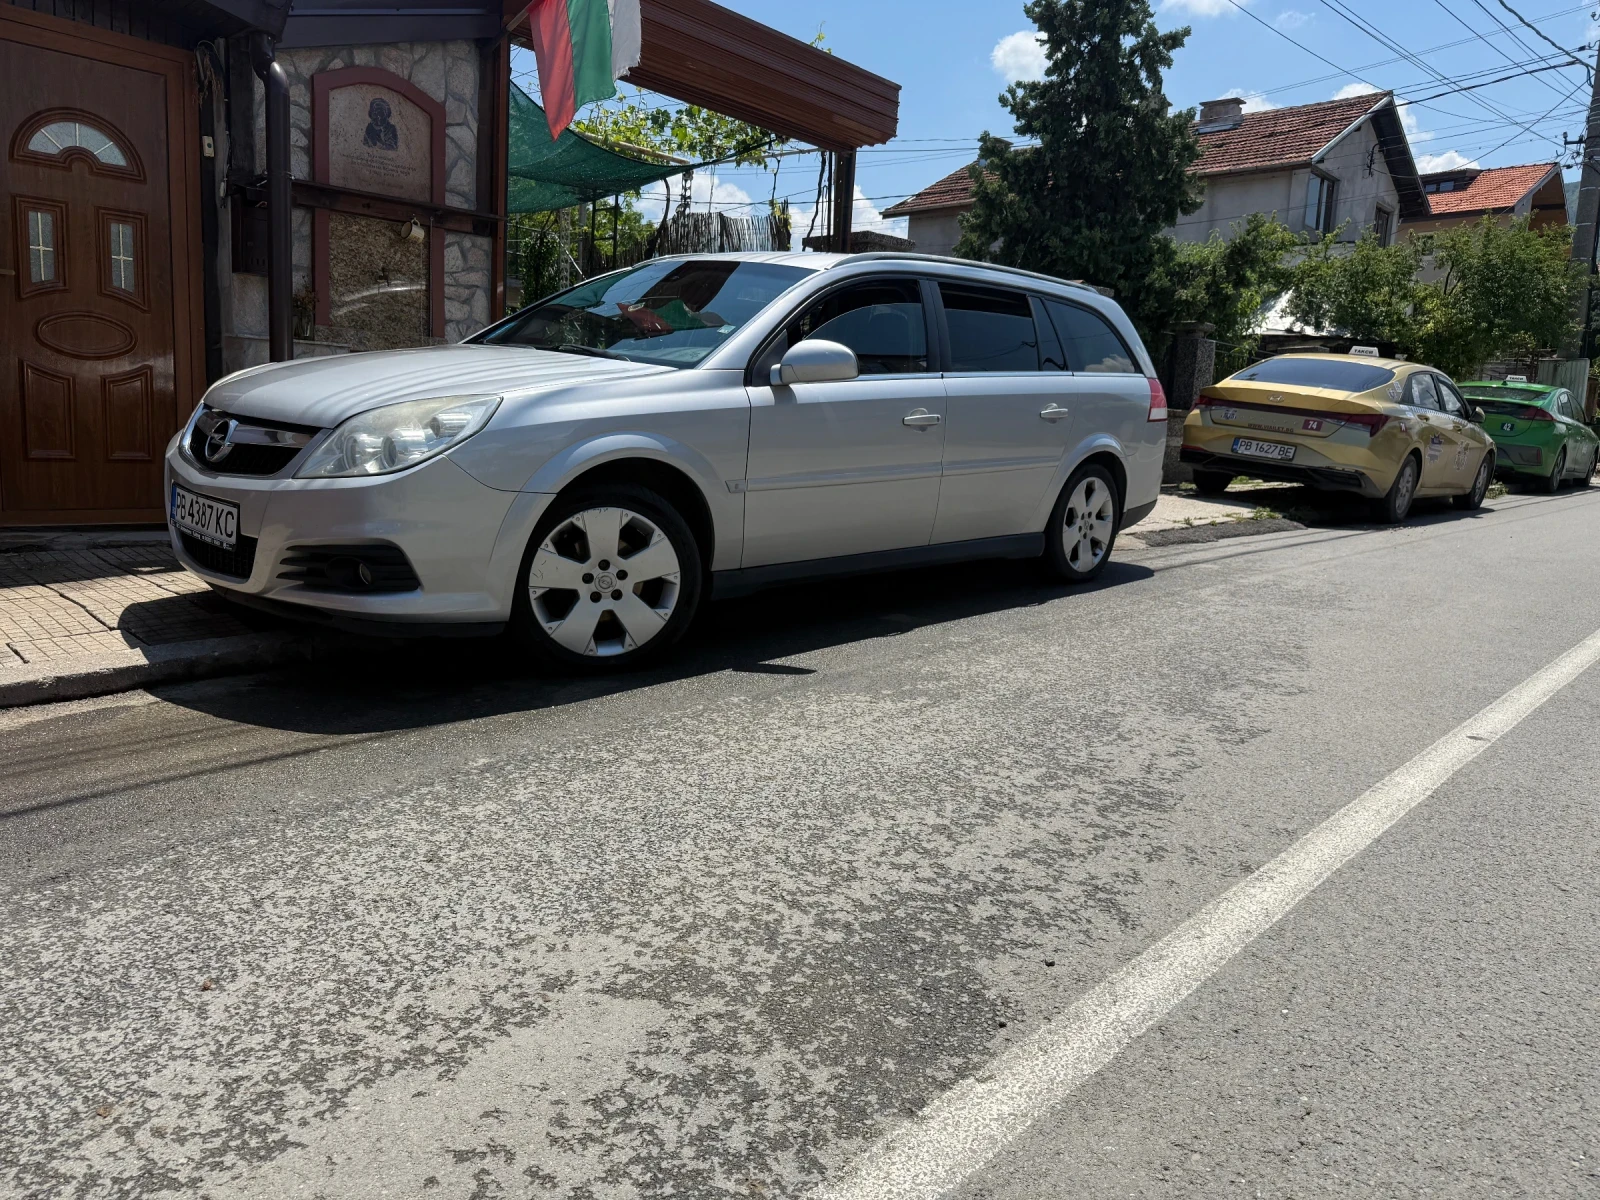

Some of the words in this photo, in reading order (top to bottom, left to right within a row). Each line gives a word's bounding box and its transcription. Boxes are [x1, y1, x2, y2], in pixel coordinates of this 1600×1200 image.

[1308, 421, 1318, 429] 74
[1503, 423, 1511, 431] 42
[1238, 440, 1252, 451] PB
[1255, 442, 1278, 454] 1627
[1278, 446, 1294, 457] BE
[176, 492, 186, 520] PB
[188, 498, 213, 530] 4387
[215, 507, 235, 538] KC
